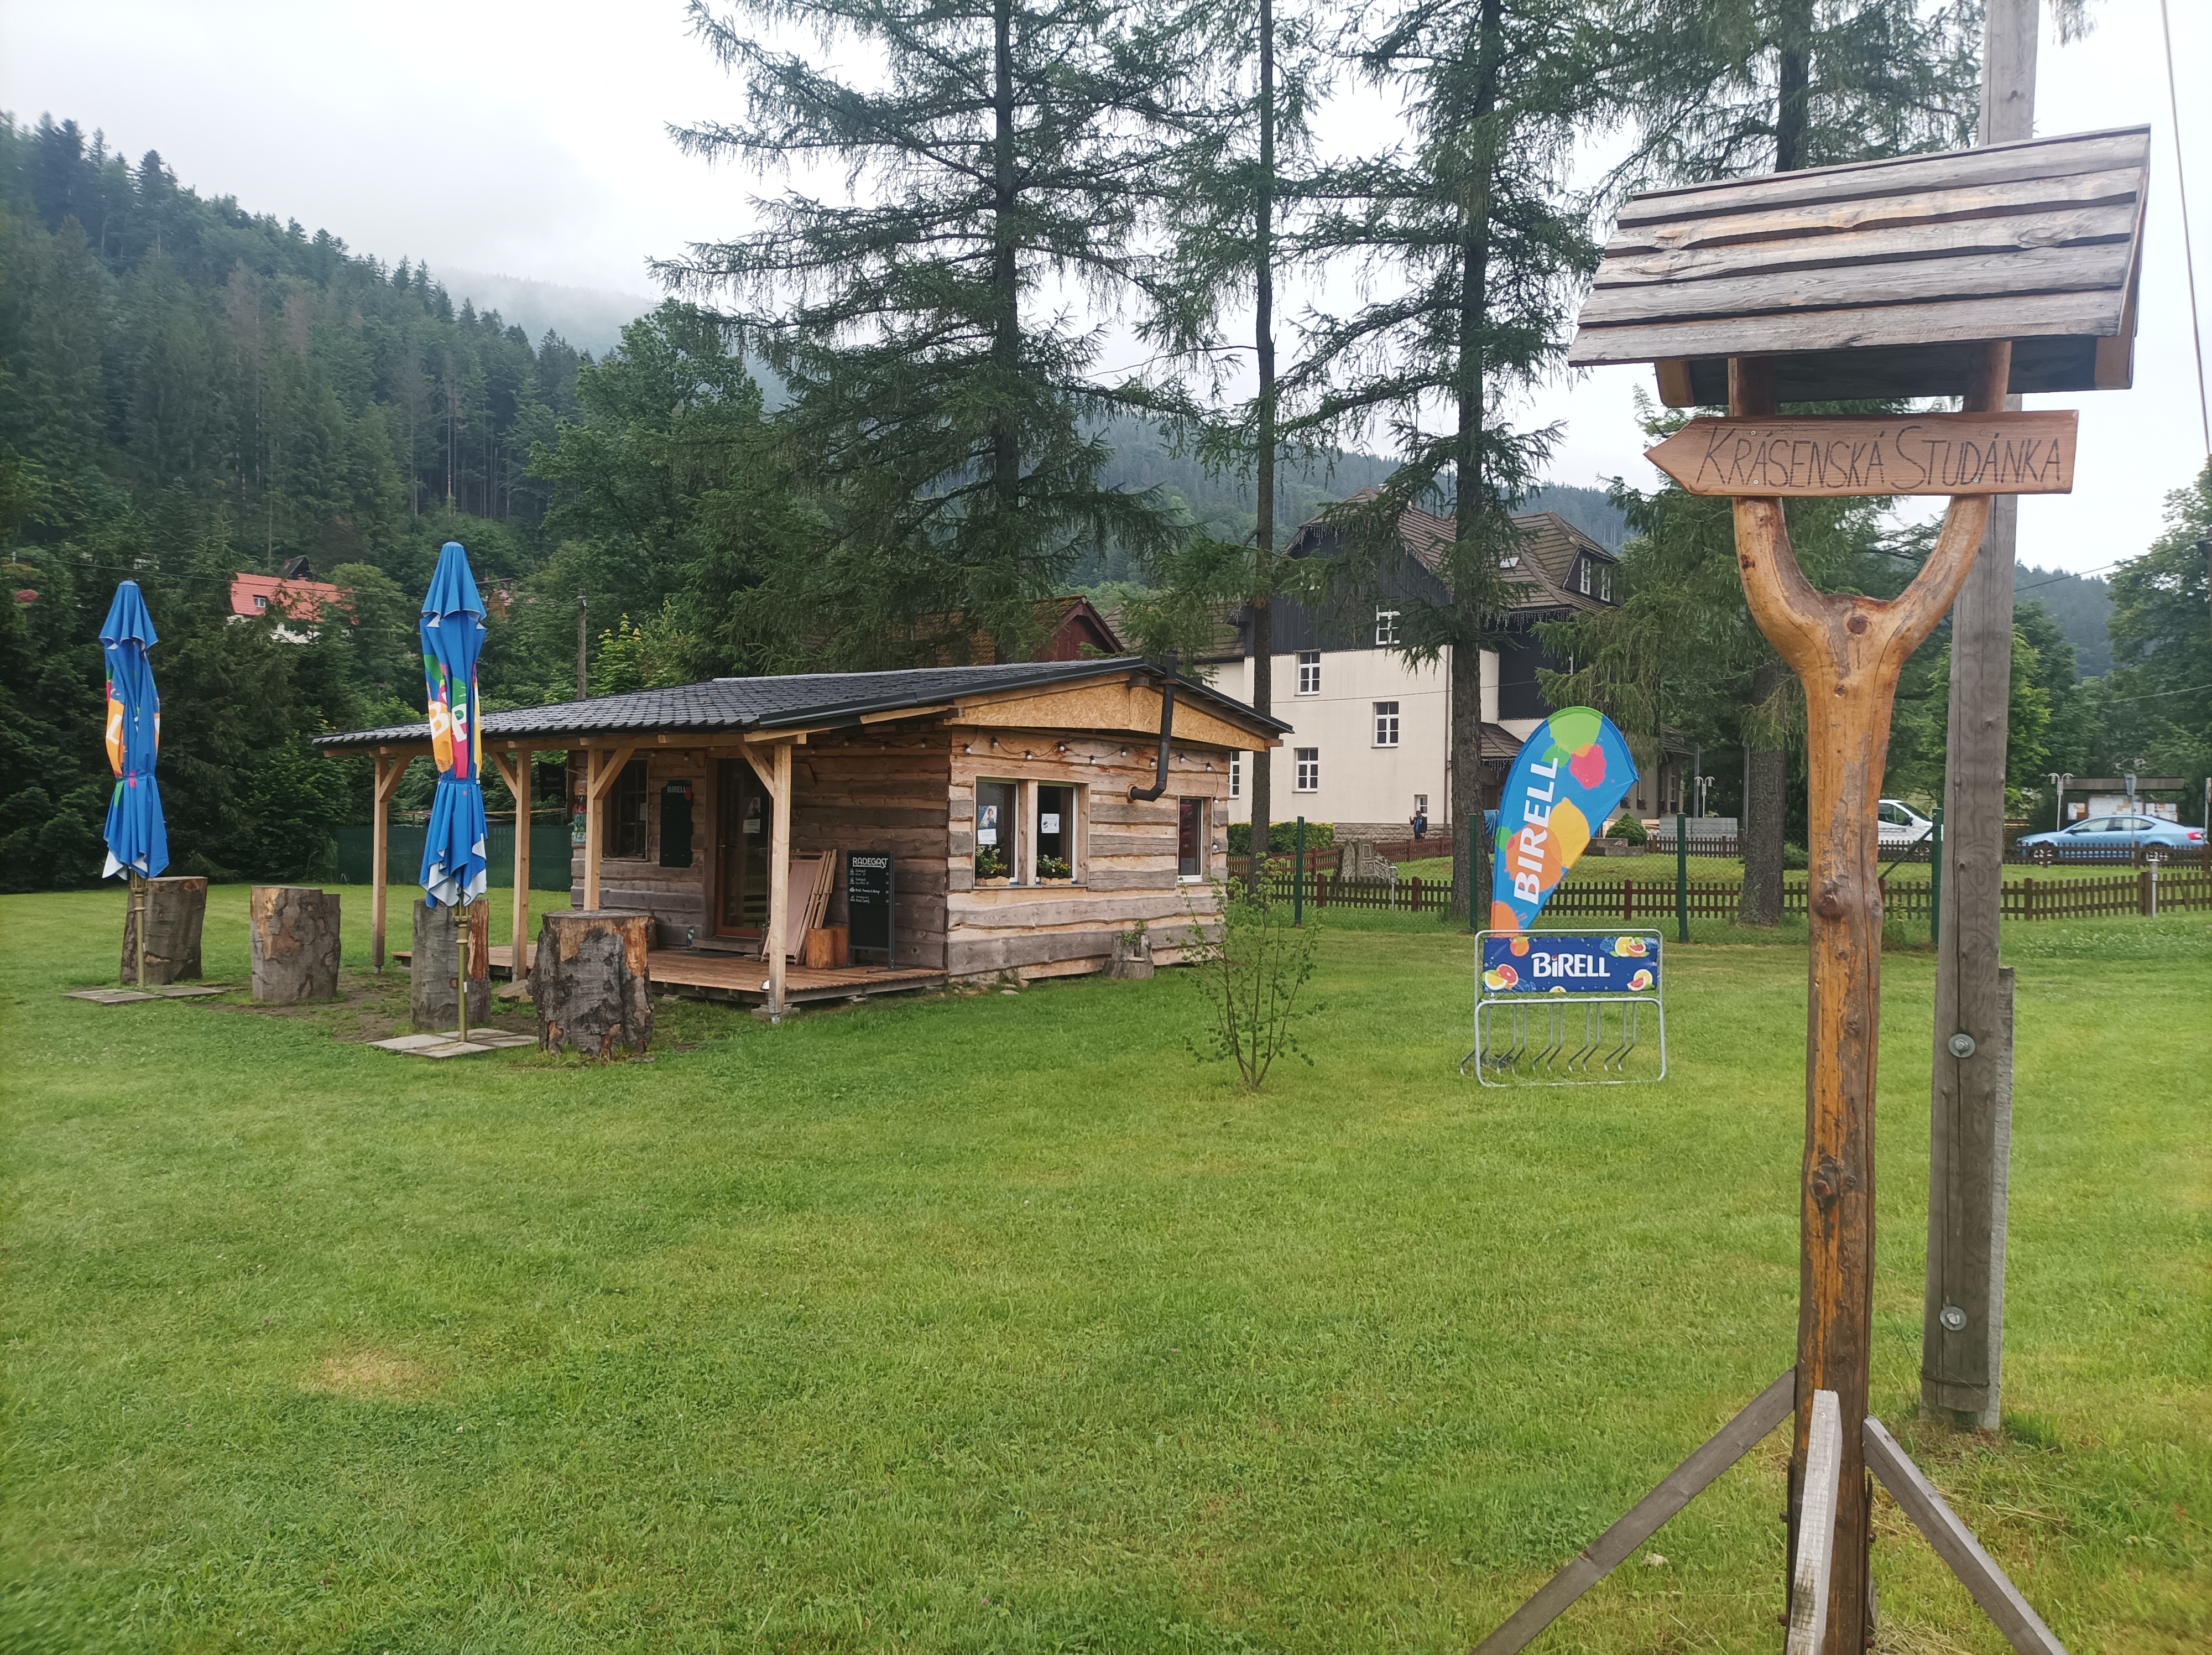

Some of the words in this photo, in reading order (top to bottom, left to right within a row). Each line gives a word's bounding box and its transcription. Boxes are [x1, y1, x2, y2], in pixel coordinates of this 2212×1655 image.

[1695, 425, 1886, 488] KRÁSENSKÁ
[1890, 425, 2061, 490] STUDÁNKA
[852, 857, 889, 869] RADEGAST
[1513, 757, 1559, 905] BIRELL
